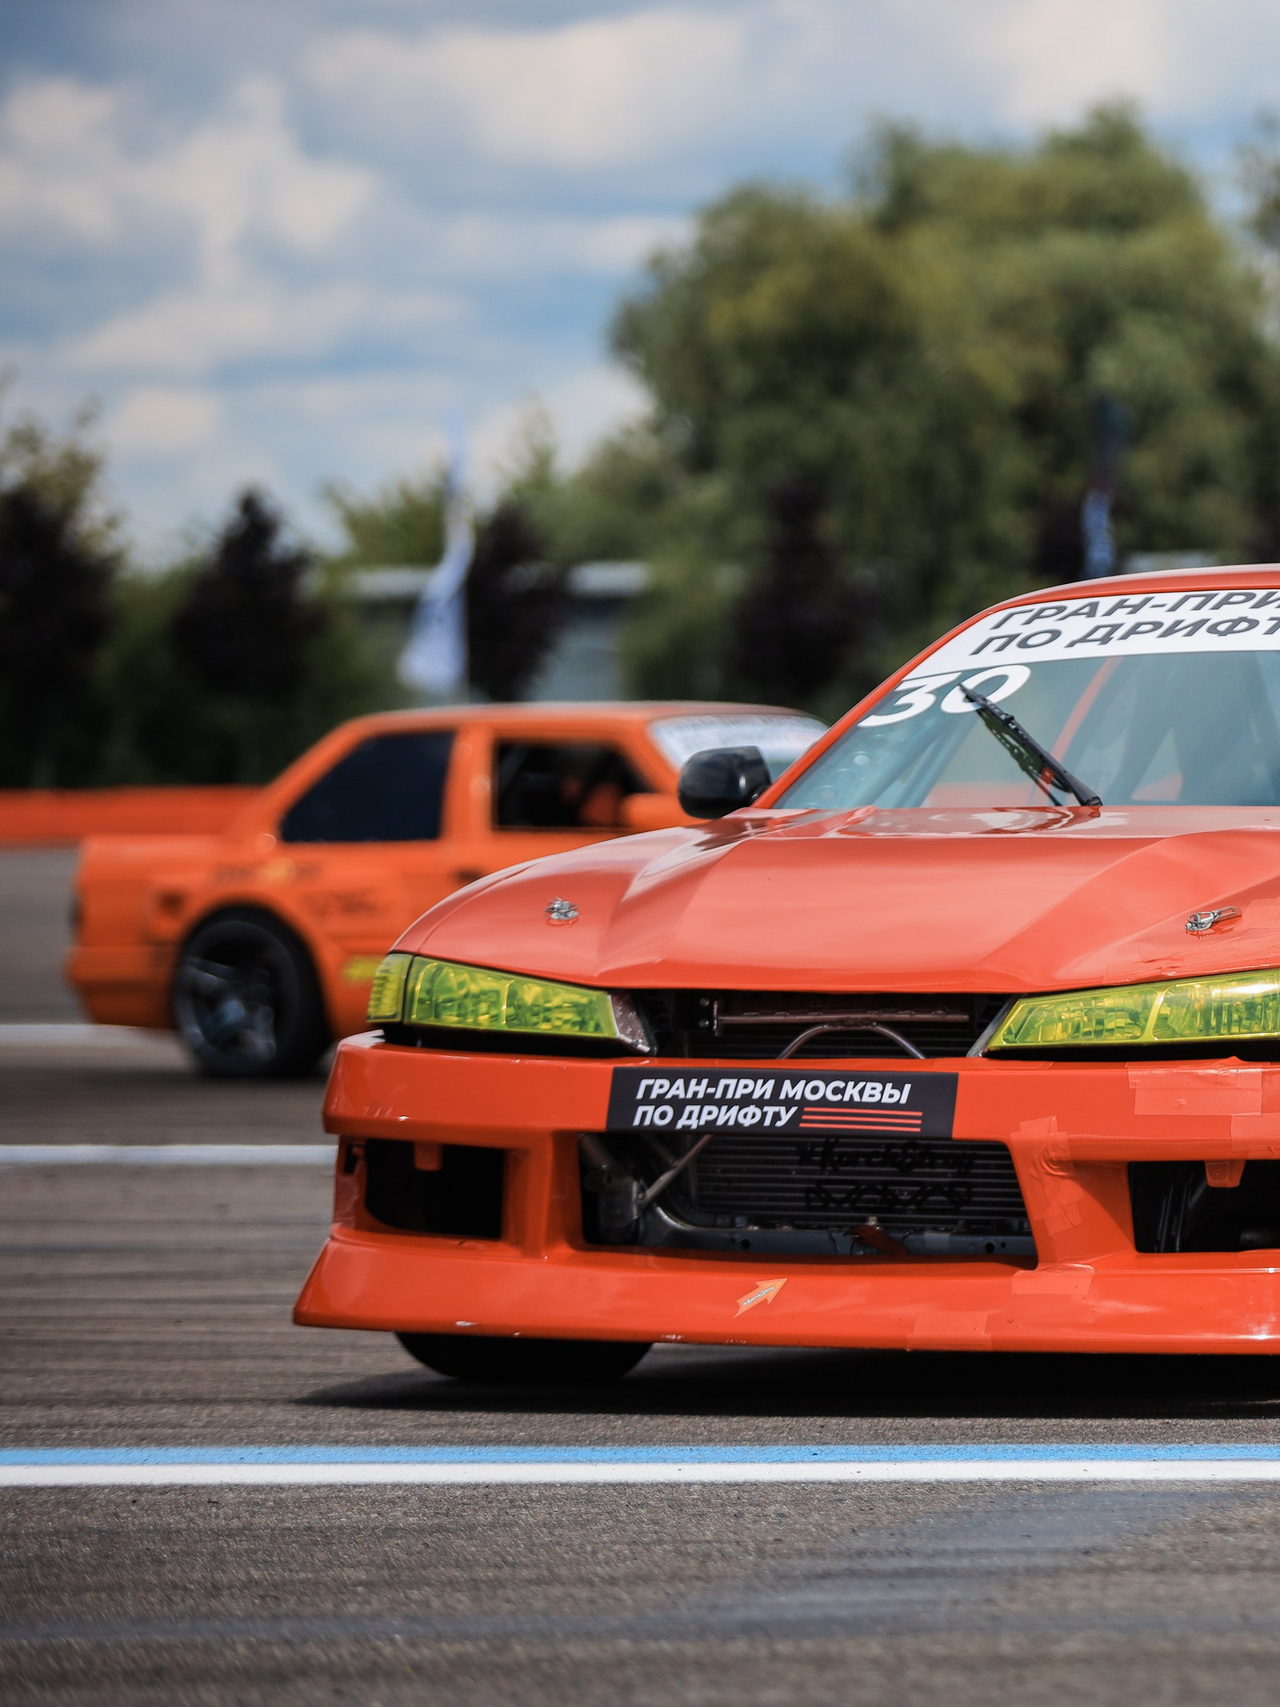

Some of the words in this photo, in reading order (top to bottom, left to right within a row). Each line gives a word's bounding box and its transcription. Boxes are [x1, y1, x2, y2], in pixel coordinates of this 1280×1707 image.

[969, 629, 1063, 656] ПО
[856, 664, 1032, 728] 30
[635, 1078, 778, 1100] ГРАН-ПРИ
[780, 1079, 912, 1104] МОСКВЫ
[632, 1104, 675, 1127] ПО
[676, 1105, 798, 1130] ДРИФТУ
